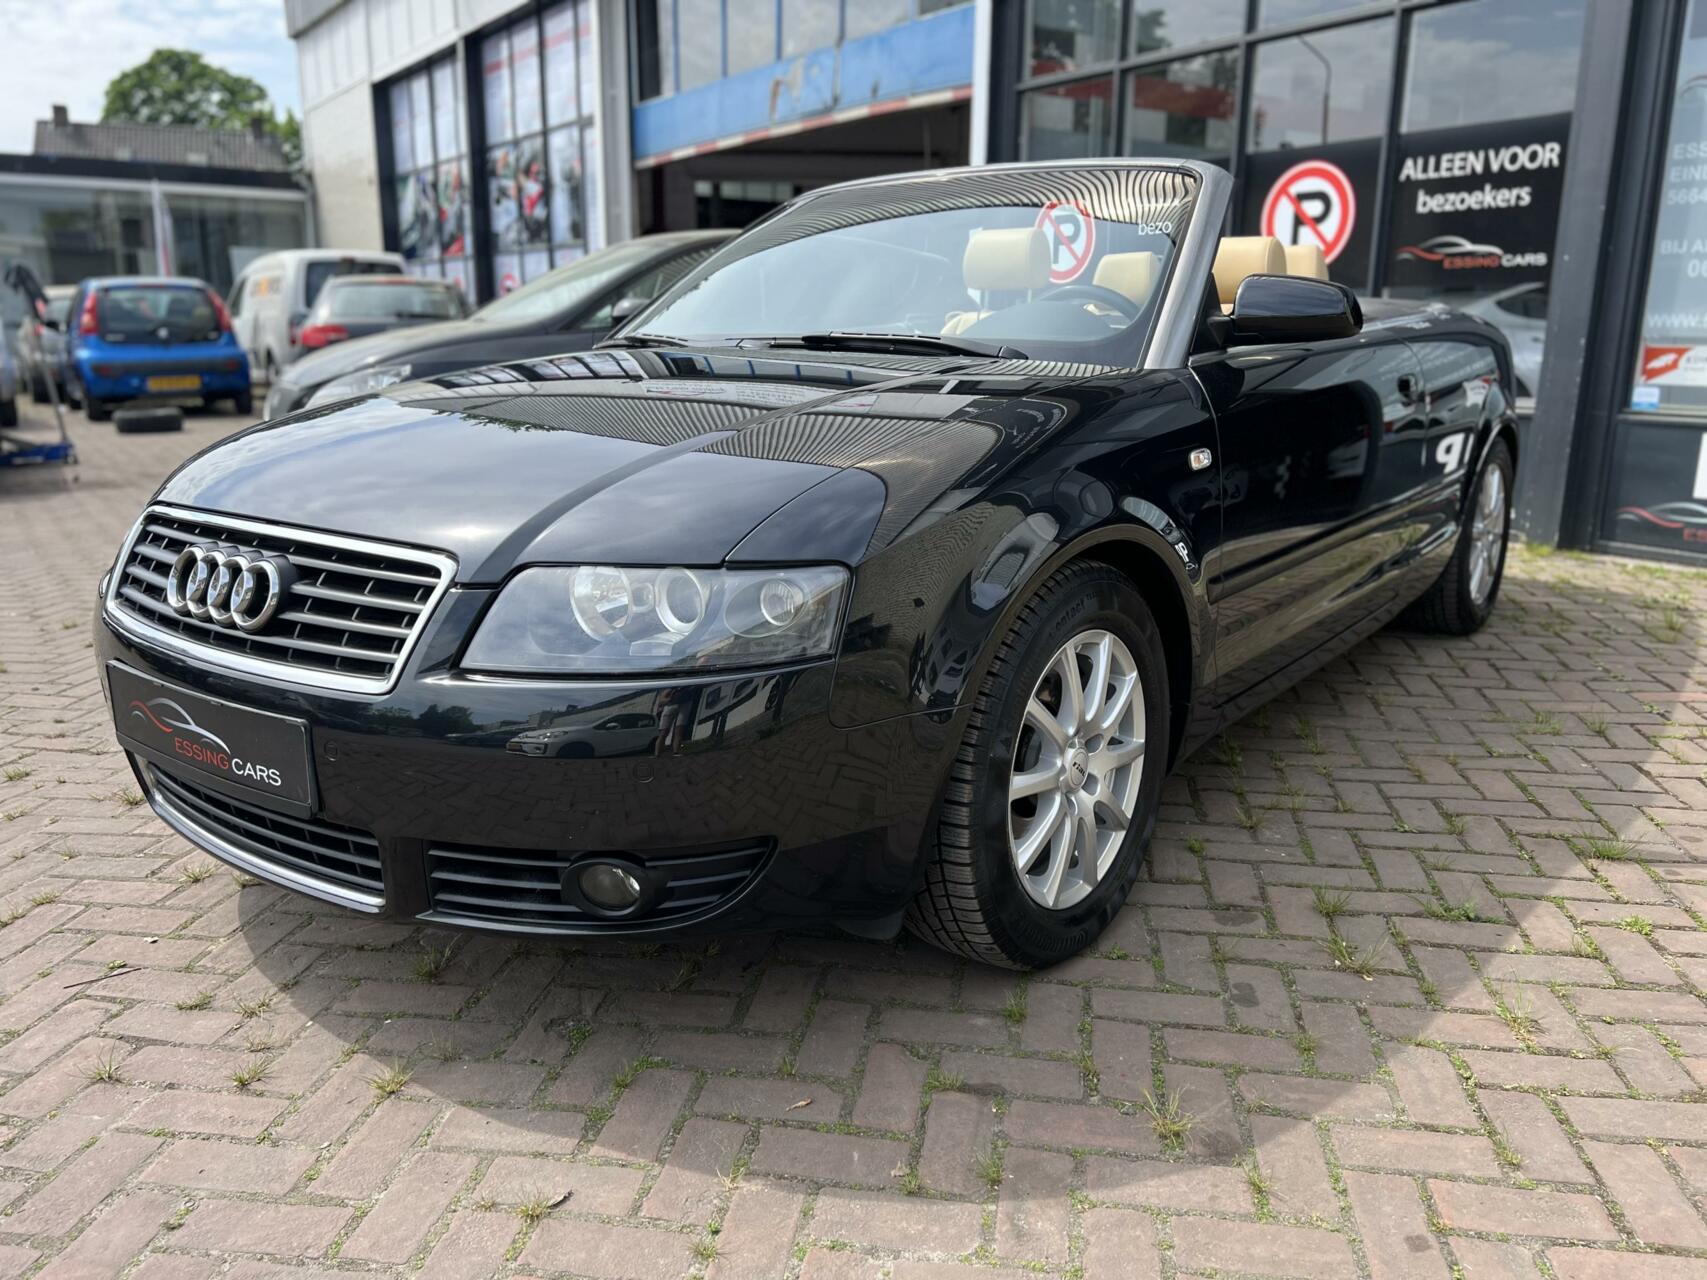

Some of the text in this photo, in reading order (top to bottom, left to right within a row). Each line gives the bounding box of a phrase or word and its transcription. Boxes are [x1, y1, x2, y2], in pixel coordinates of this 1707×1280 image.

[1399, 142, 1561, 182] ALLEEN VOOR
[1416, 182, 1532, 214] bezoekers
[1501, 252, 1547, 267] CARS
[174, 737, 282, 786] ESSING CARS
